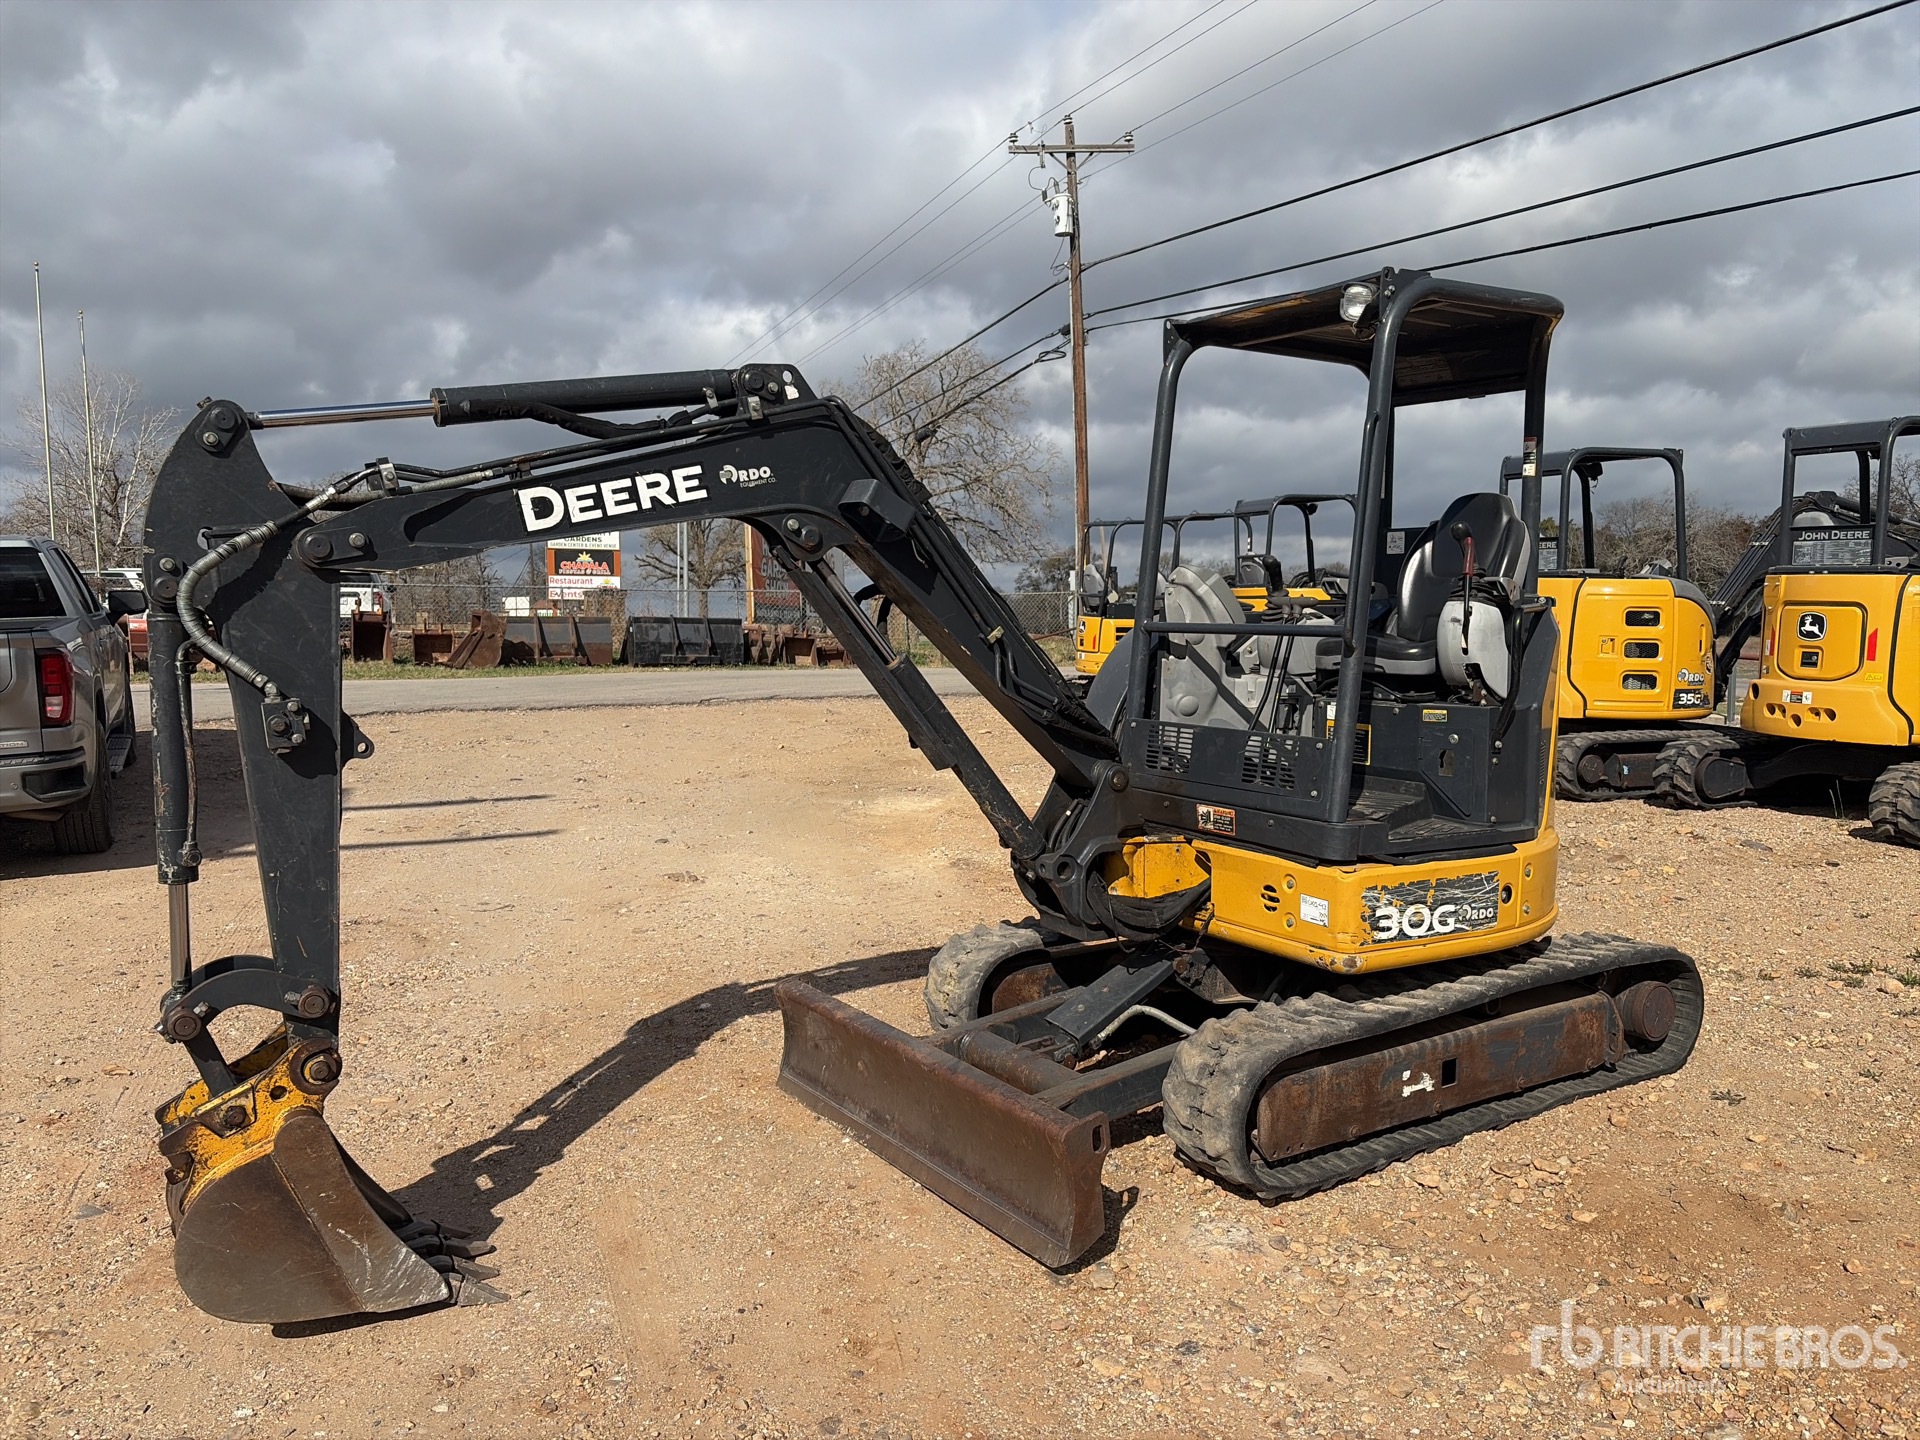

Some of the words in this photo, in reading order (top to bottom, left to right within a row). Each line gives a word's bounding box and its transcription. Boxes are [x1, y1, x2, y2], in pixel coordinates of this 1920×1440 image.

[738, 466, 771, 482] RDO
[517, 464, 708, 532] DEERE
[1798, 531, 1829, 541] JOHN
[1831, 530, 1870, 540] DEERE
[1539, 541, 1557, 549] EERE
[560, 561, 609, 570] CHAPALA
[549, 576, 593, 585] Restaurant
[549, 590, 583, 598] Events
[1678, 693, 1702, 705] 35G
[1471, 907, 1494, 920] RDO
[1374, 904, 1456, 939] 30G
